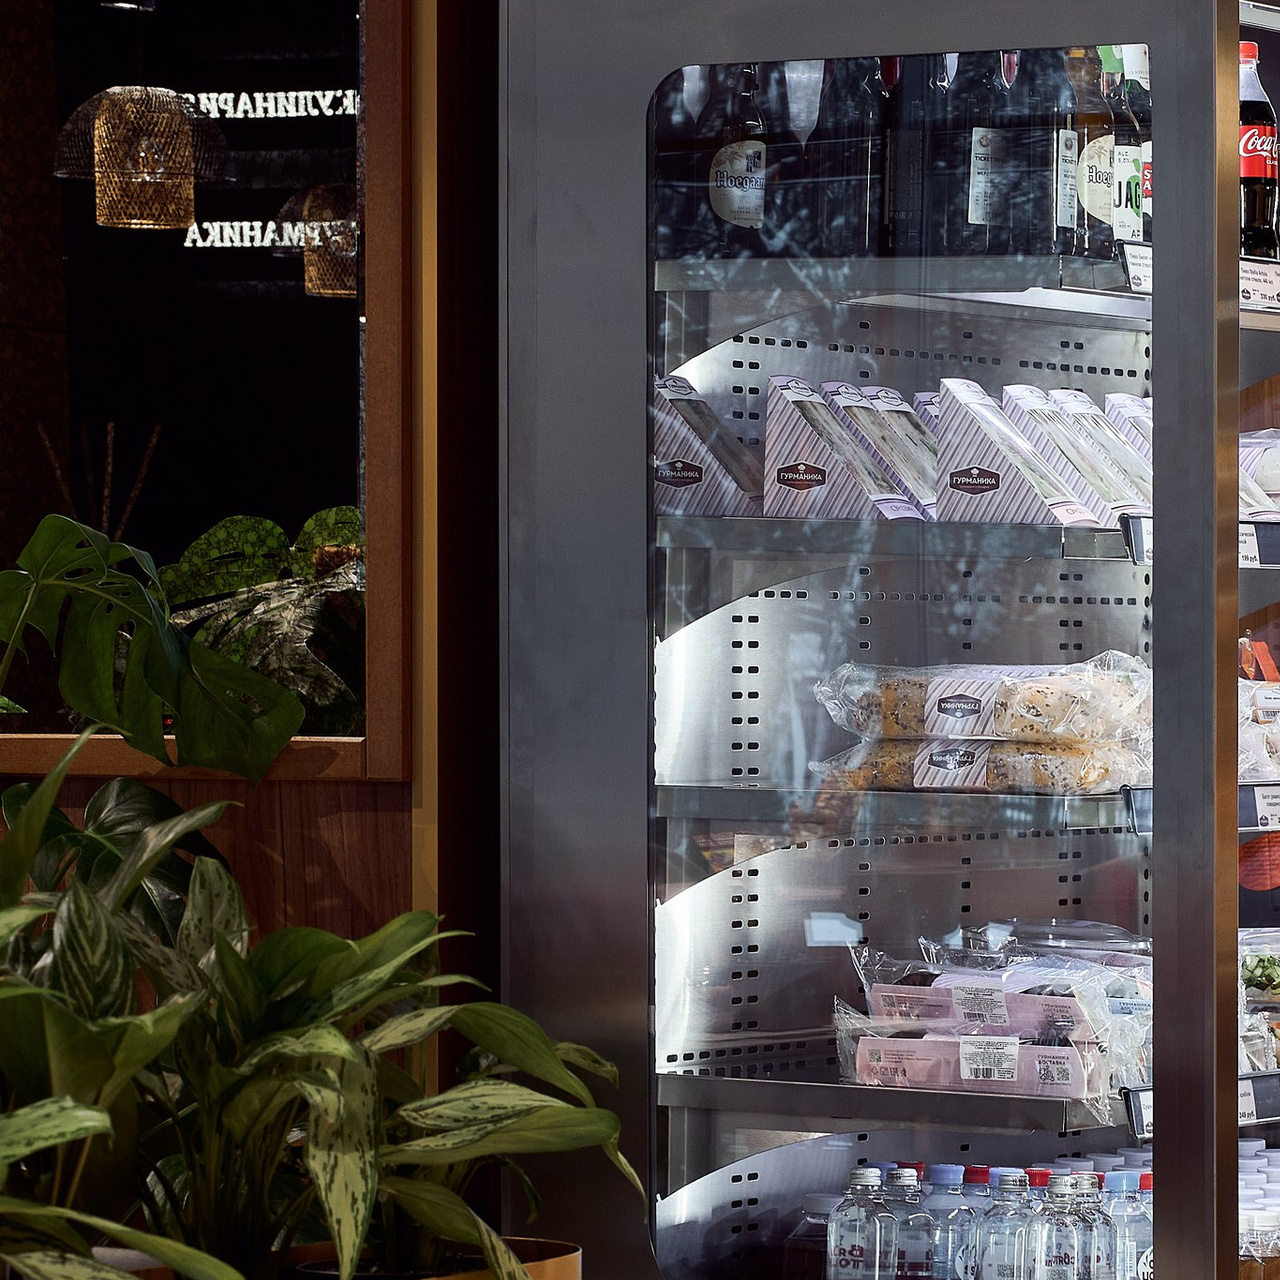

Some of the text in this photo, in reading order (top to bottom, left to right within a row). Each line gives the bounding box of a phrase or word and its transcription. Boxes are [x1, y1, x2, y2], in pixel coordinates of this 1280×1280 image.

[657, 469, 700, 479] ГУРМАНИКА
[780, 472, 823, 481] ГУРМАНИКА
[953, 476, 997, 485] ГУРМАНИКА
